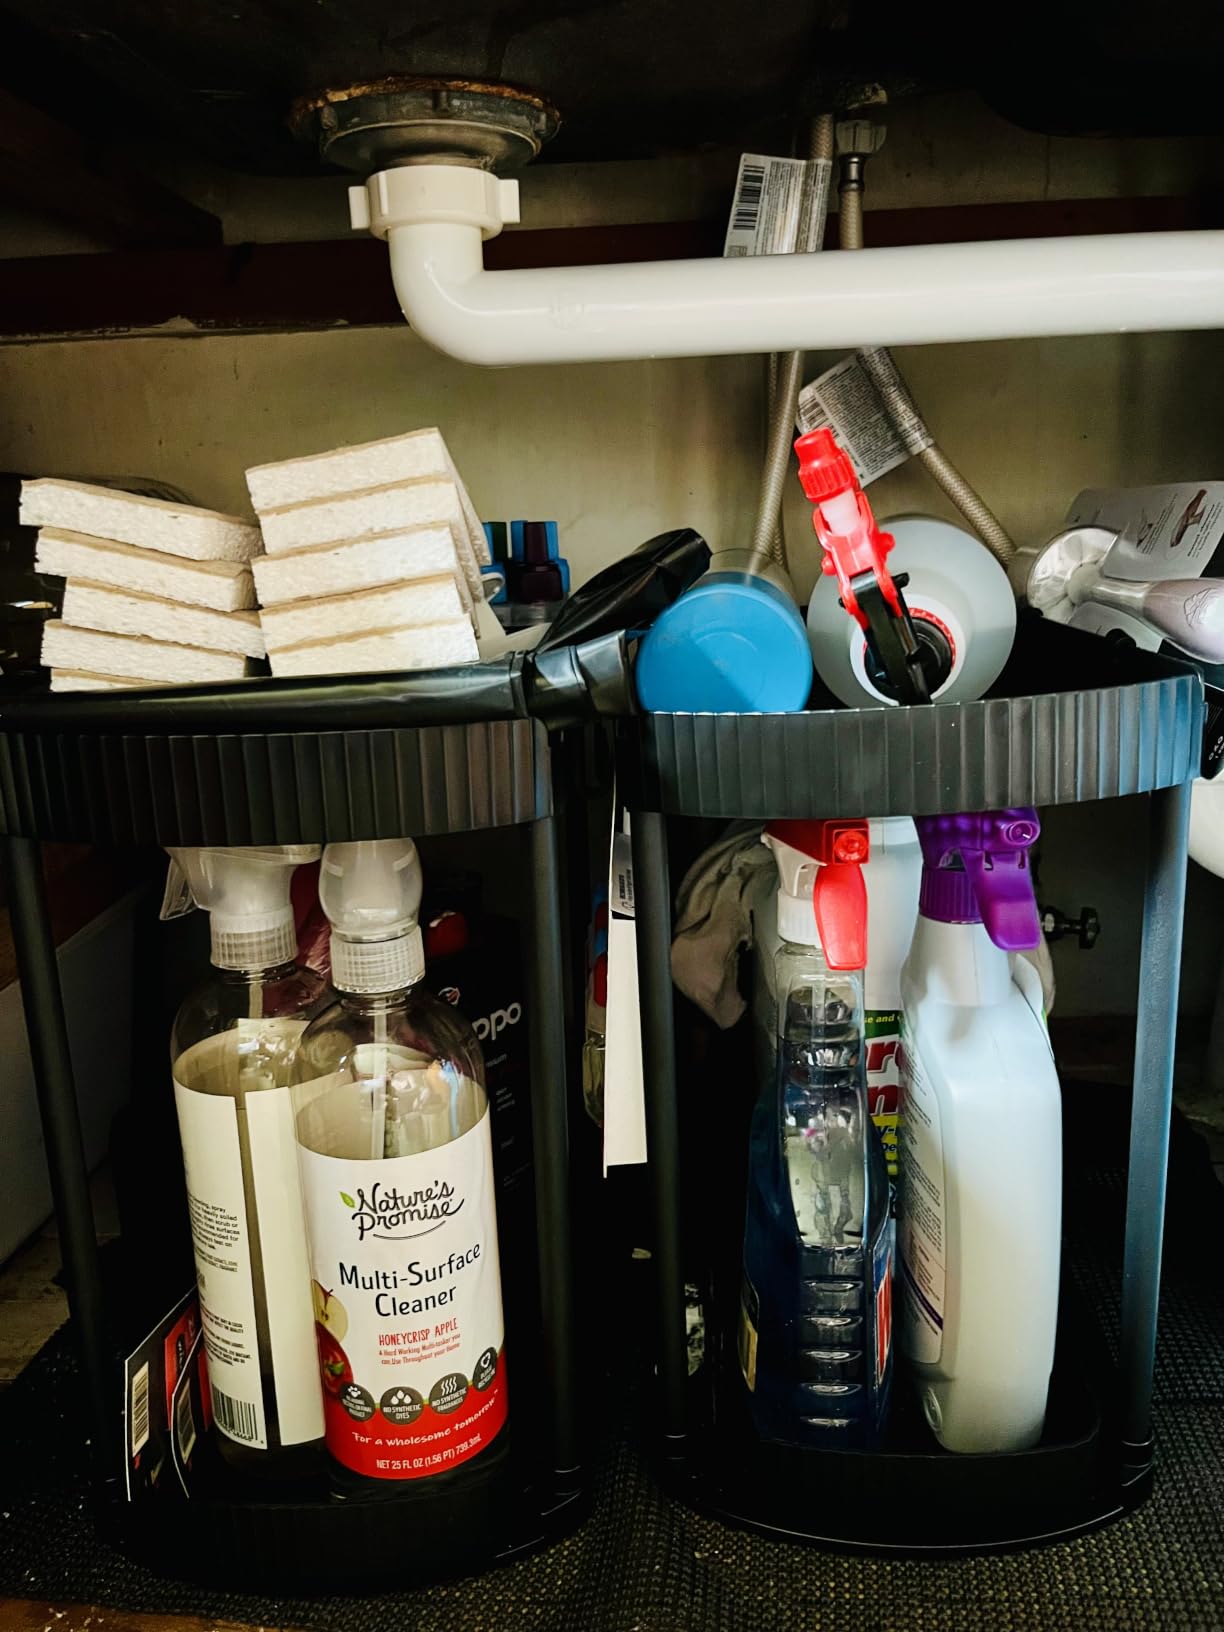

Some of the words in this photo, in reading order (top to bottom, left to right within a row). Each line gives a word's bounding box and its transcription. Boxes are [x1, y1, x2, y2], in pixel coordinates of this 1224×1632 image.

[876, 1014, 895, 1023] and
[357, 1180, 454, 1214] Nature's
[352, 1199, 464, 1241] Promise
[339, 1244, 480, 1290] Multi-Surface
[375, 1286, 456, 1316] Cleaner
[379, 1328, 430, 1346] HONEYCRISP
[435, 1318, 458, 1337] APPLE
[441, 1387, 467, 1403] SYNTHETIC
[392, 1404, 421, 1412] SYNTHETIC
[352, 1432, 372, 1443] For
[386, 1428, 451, 1447] wholesome
[376, 1459, 390, 1469] NET
[392, 1461, 400, 1469] 25
[413, 1458, 423, 1468] OZ
[443, 1448, 455, 1460] PT)
